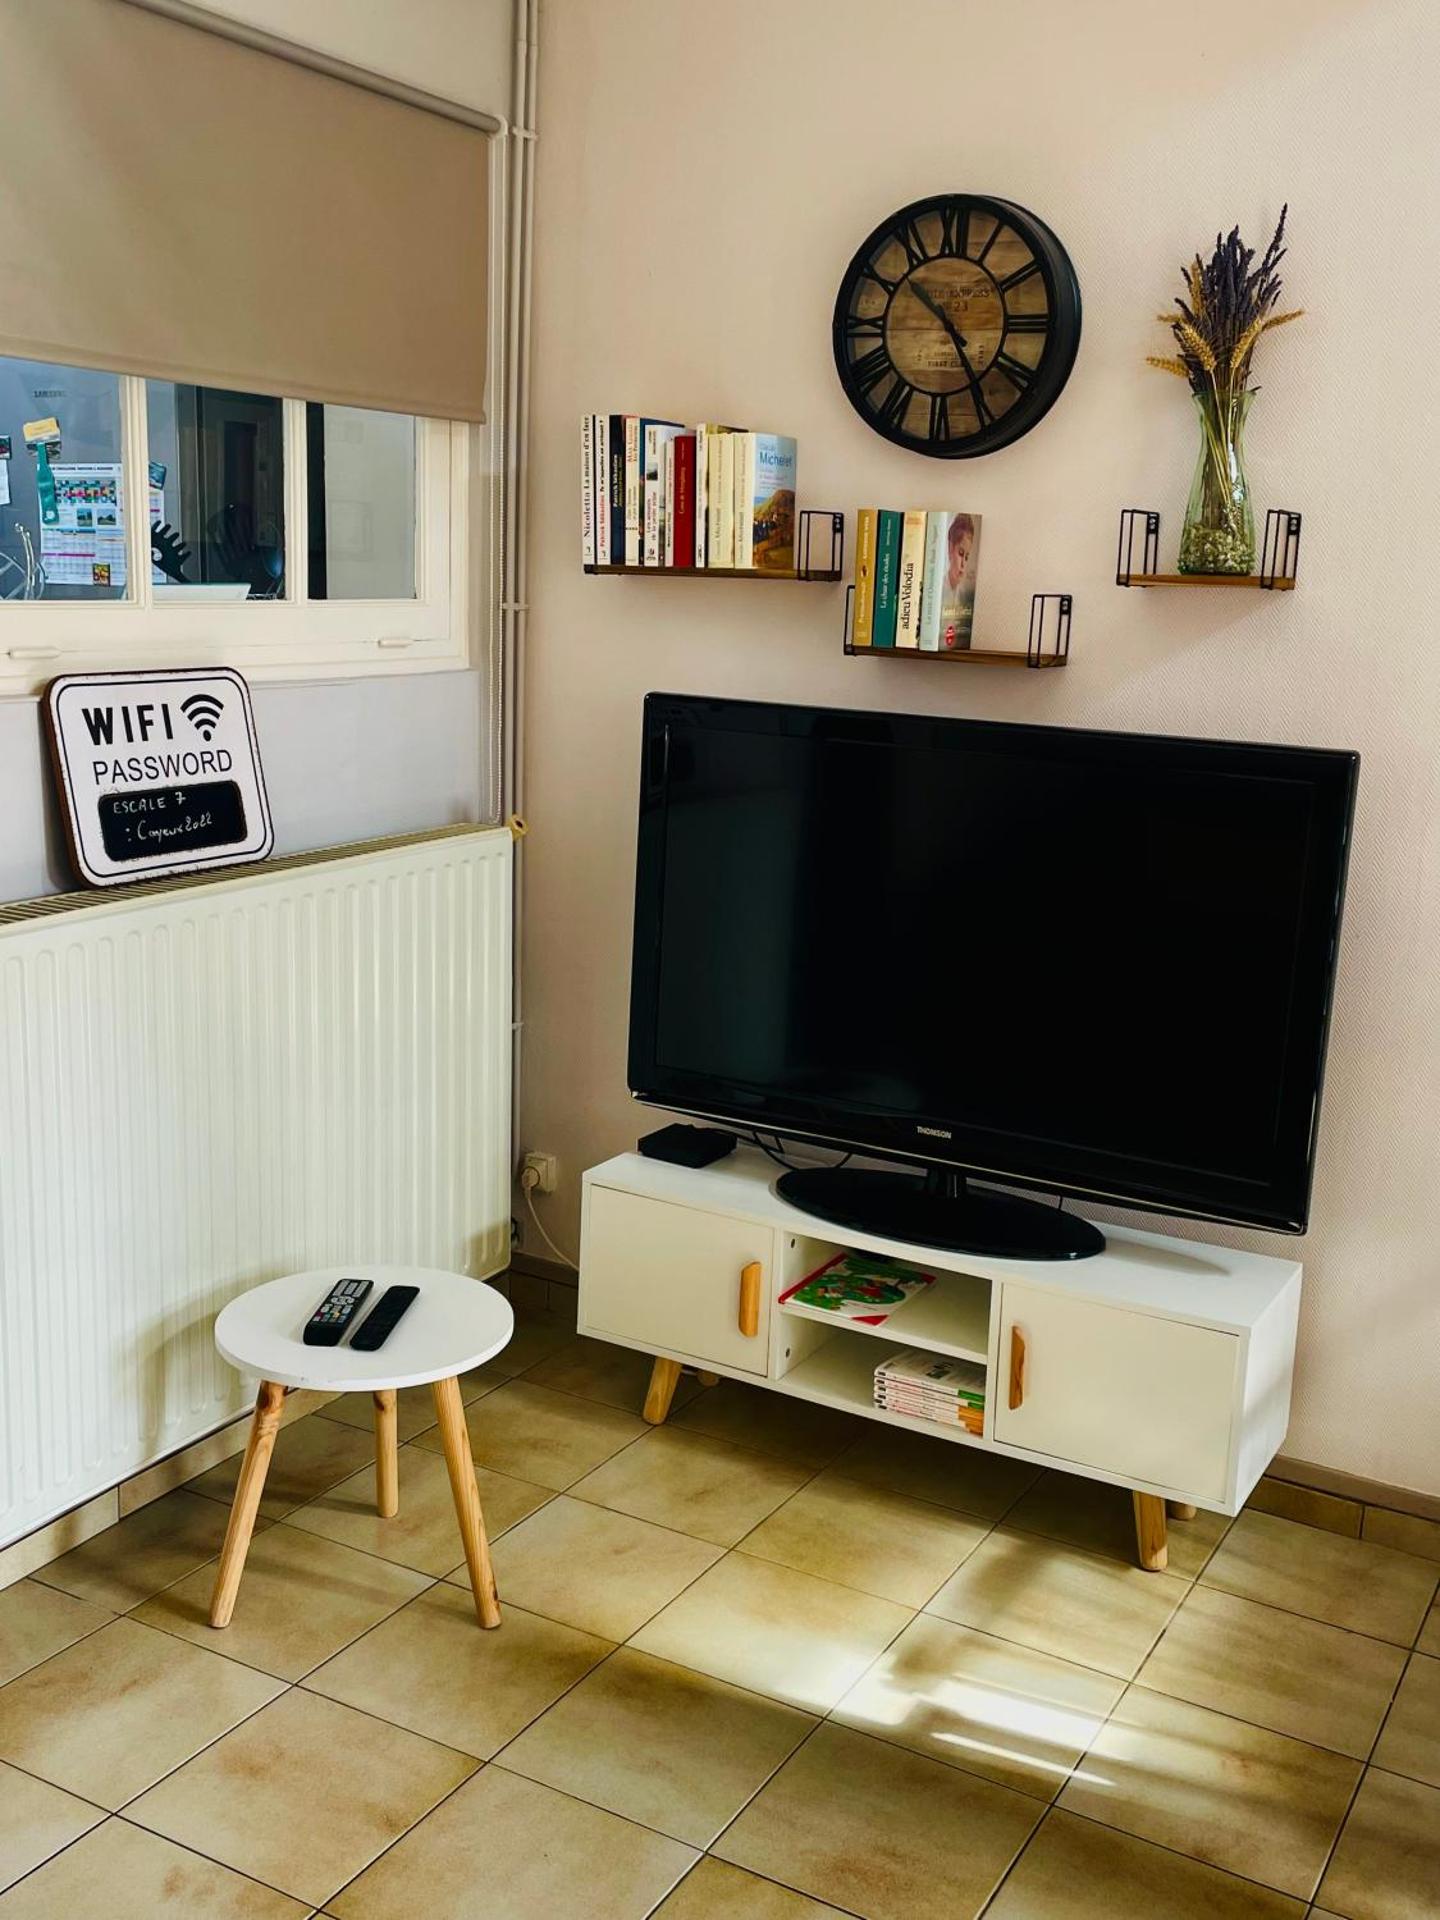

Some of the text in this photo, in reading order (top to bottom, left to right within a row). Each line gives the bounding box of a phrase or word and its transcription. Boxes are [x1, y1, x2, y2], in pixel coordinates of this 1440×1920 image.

[759, 452, 793, 467] Michelet
[583, 492, 591, 538] Nicoletta
[900, 562, 914, 630] adieu Volodia
[81, 703, 174, 746] WIFI
[92, 749, 233, 786] PASSWORD
[113, 791, 187, 814] ESCALE 7
[916, 1125, 952, 1140] THOMSON
